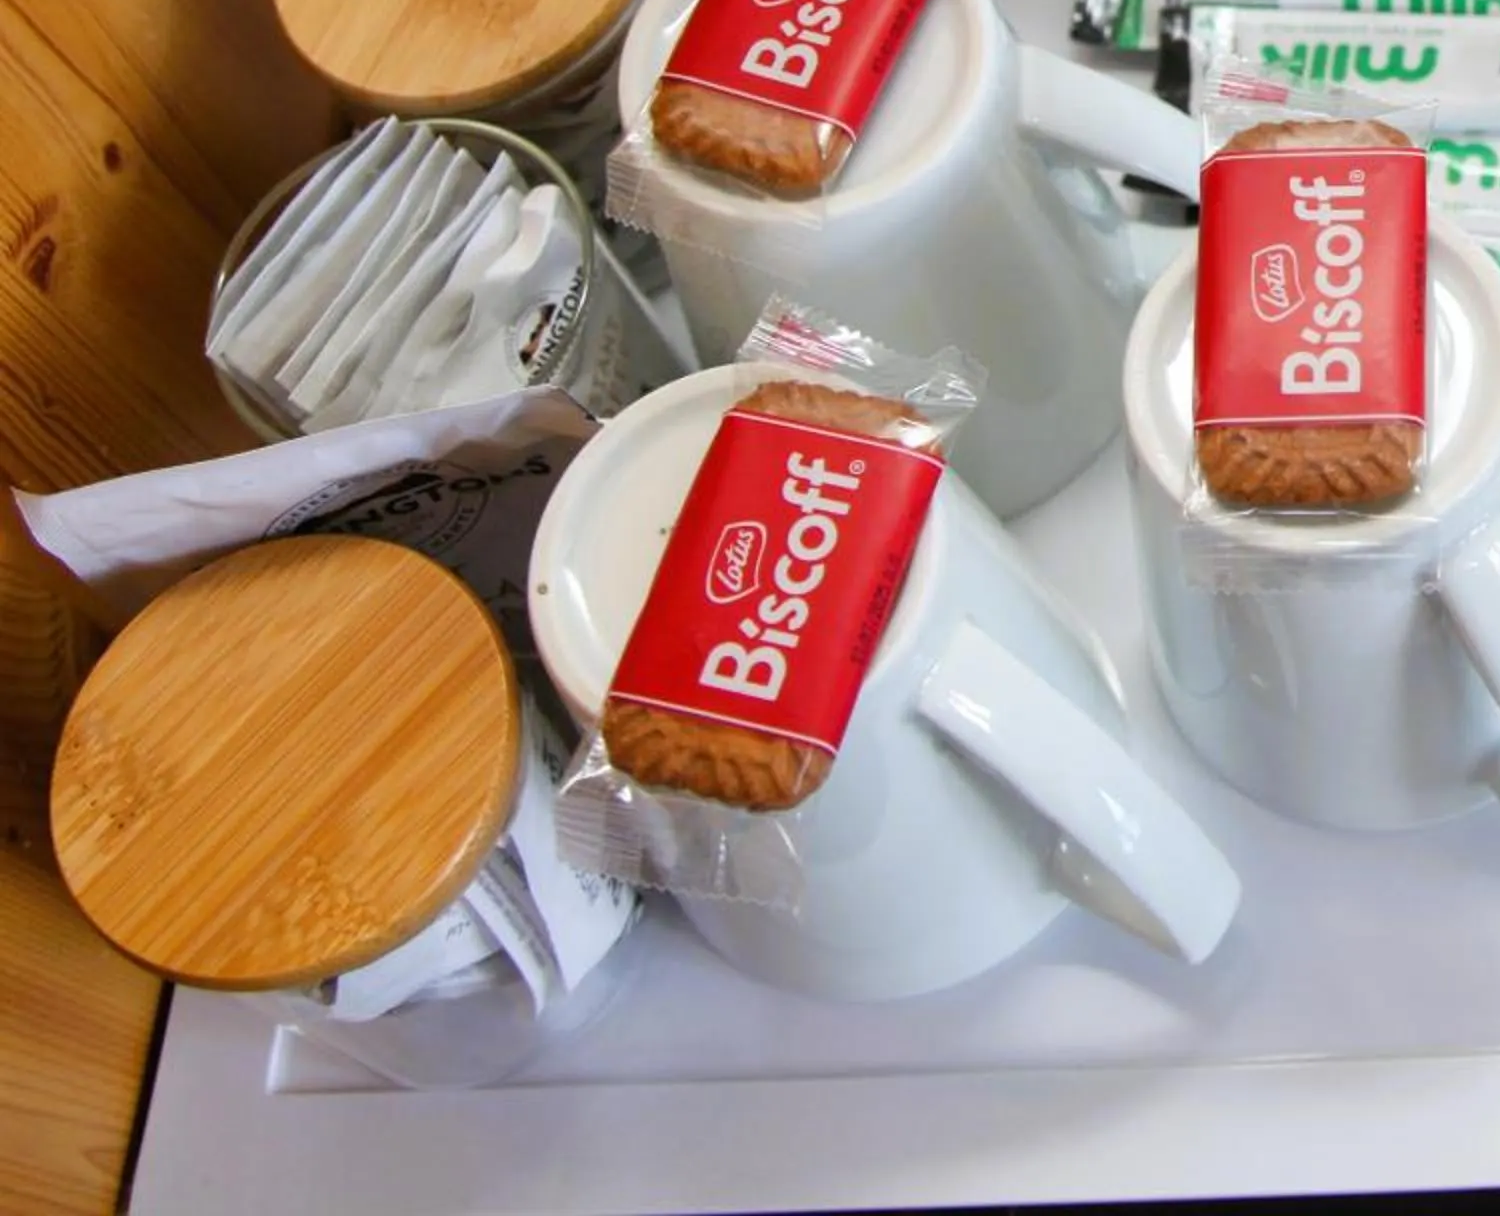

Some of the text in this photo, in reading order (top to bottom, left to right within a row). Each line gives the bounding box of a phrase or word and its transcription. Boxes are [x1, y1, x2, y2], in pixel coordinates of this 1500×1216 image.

[1280, 175, 1366, 395] Biscoff
[698, 451, 862, 702] Biscoff
[714, 529, 756, 592] Lotus
